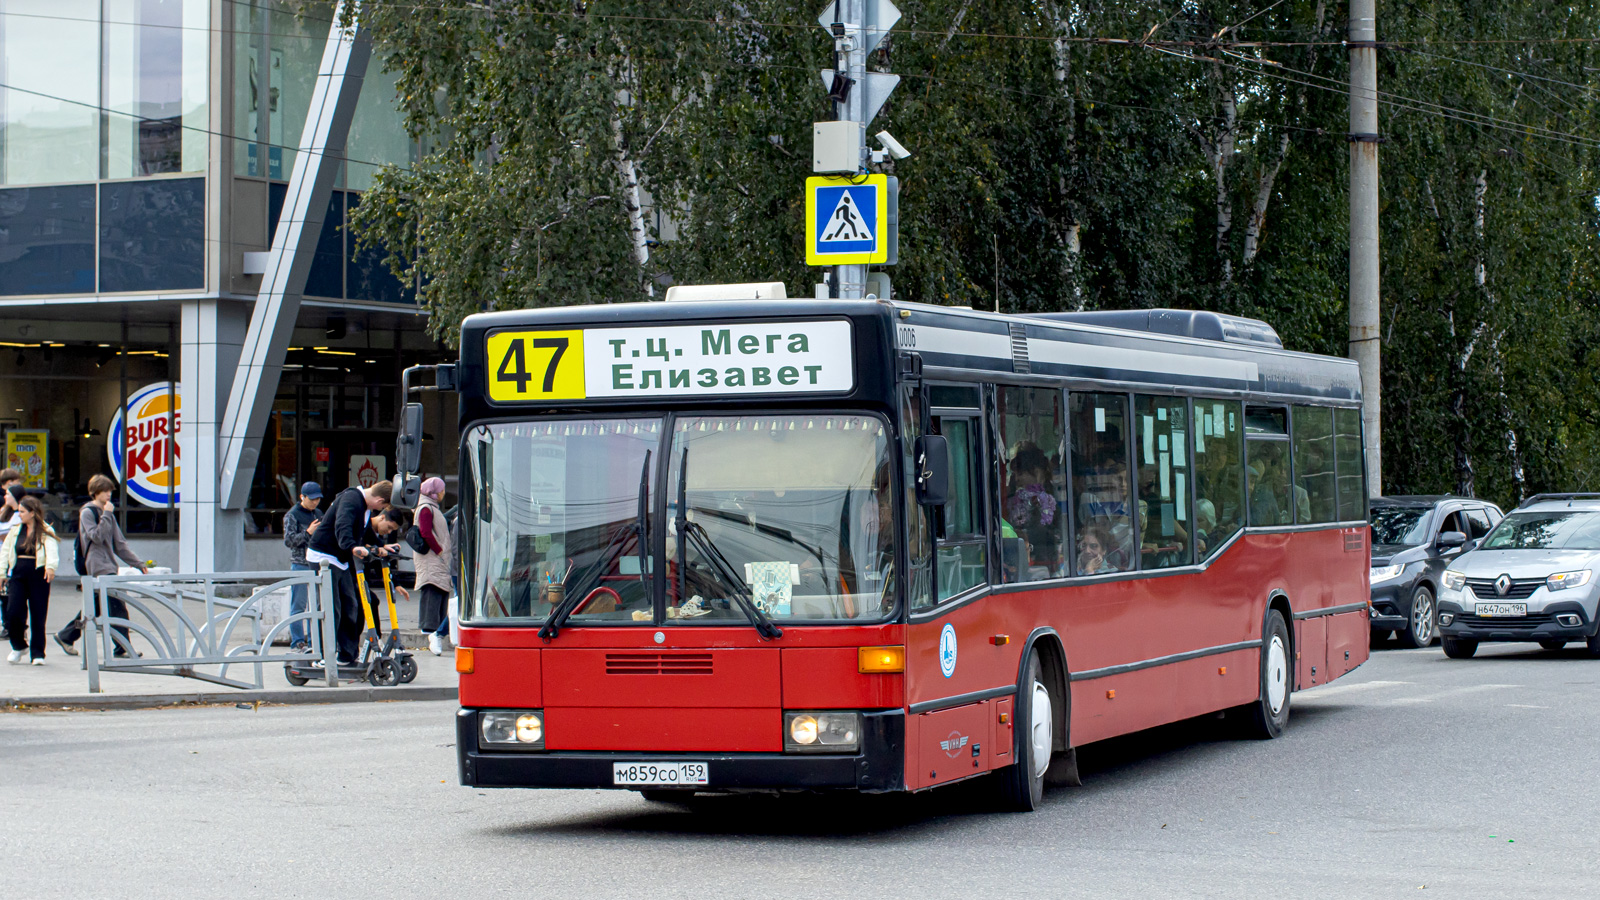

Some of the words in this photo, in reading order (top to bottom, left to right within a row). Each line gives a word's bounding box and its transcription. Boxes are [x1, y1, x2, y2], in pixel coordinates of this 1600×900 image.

[608, 338, 683, 361] т.ц.
[701, 329, 810, 356] Мега
[899, 326, 916, 348] 0006
[496, 337, 569, 394] 47
[611, 364, 823, 390] Елизавет
[681, 764, 704, 777] 159
